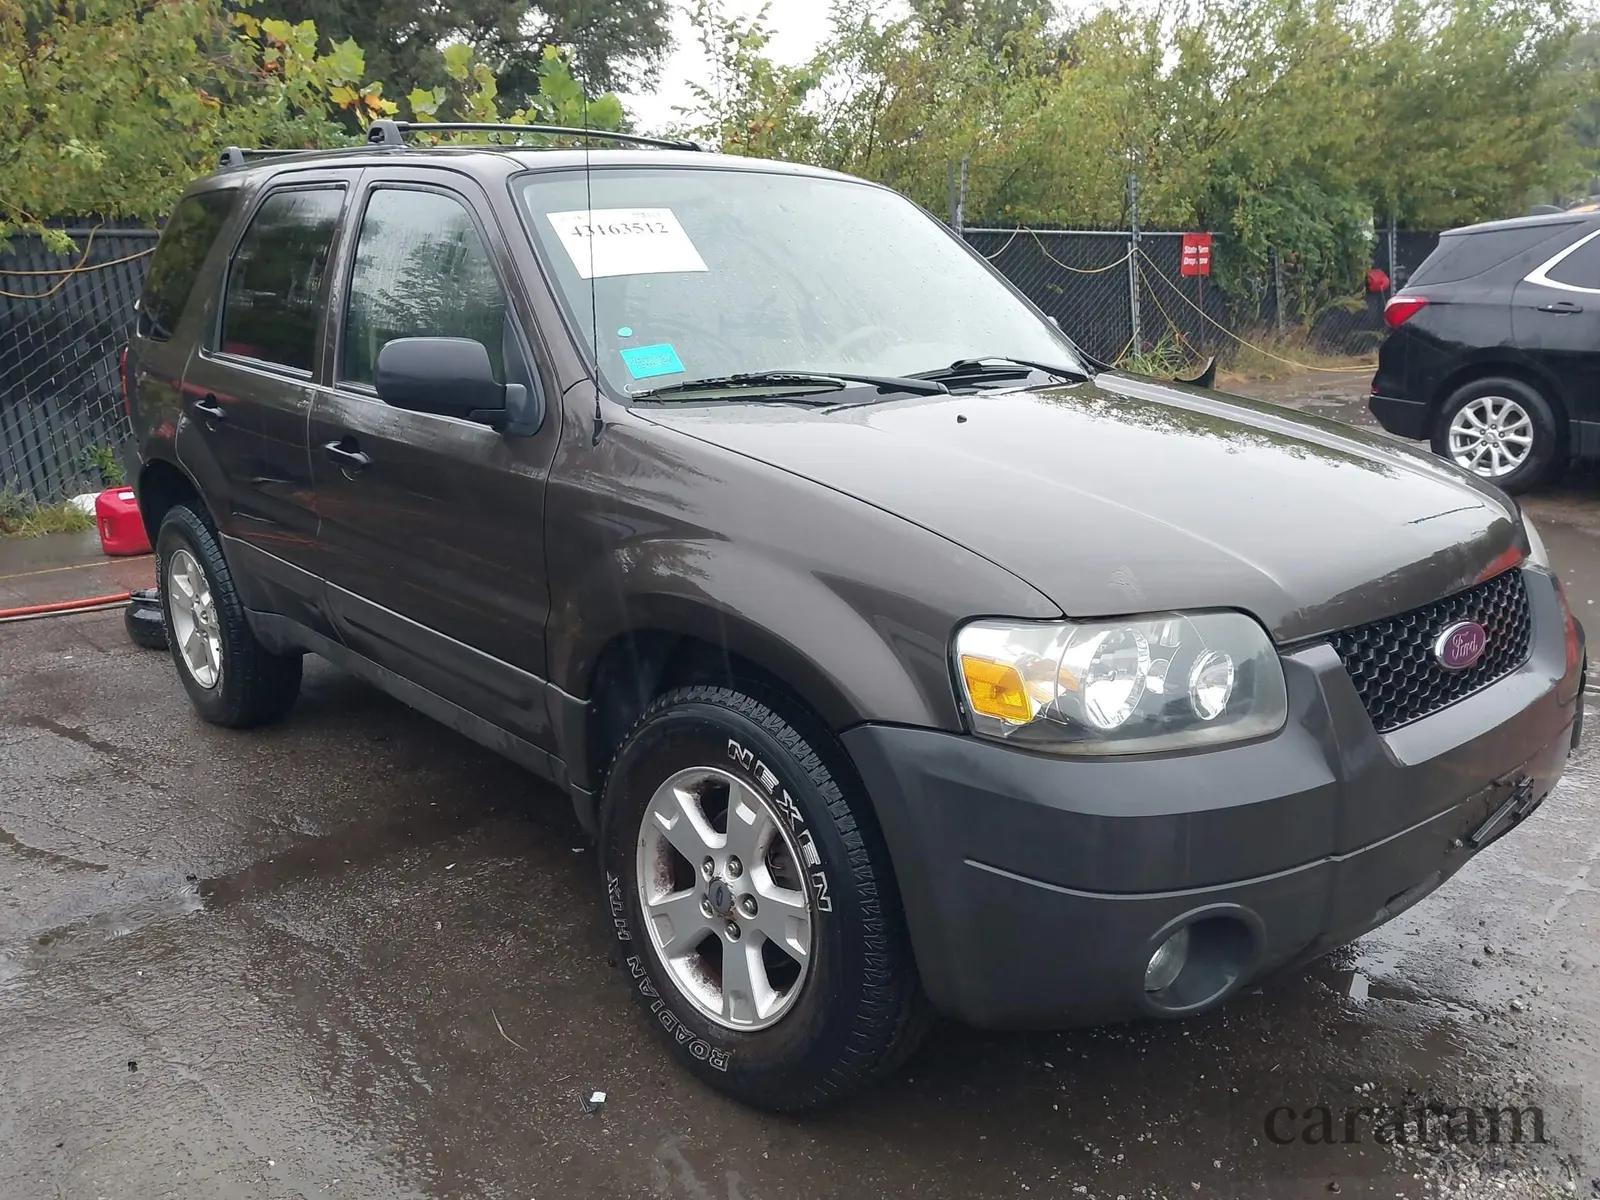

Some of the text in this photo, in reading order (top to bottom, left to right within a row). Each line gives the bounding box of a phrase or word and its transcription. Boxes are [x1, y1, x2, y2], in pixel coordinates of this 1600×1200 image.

[571, 221, 669, 238] 43163512
[1451, 631, 1479, 661] Ford
[727, 738, 833, 913] NEXEN
[605, 870, 733, 1073] ROADIAN HTX
